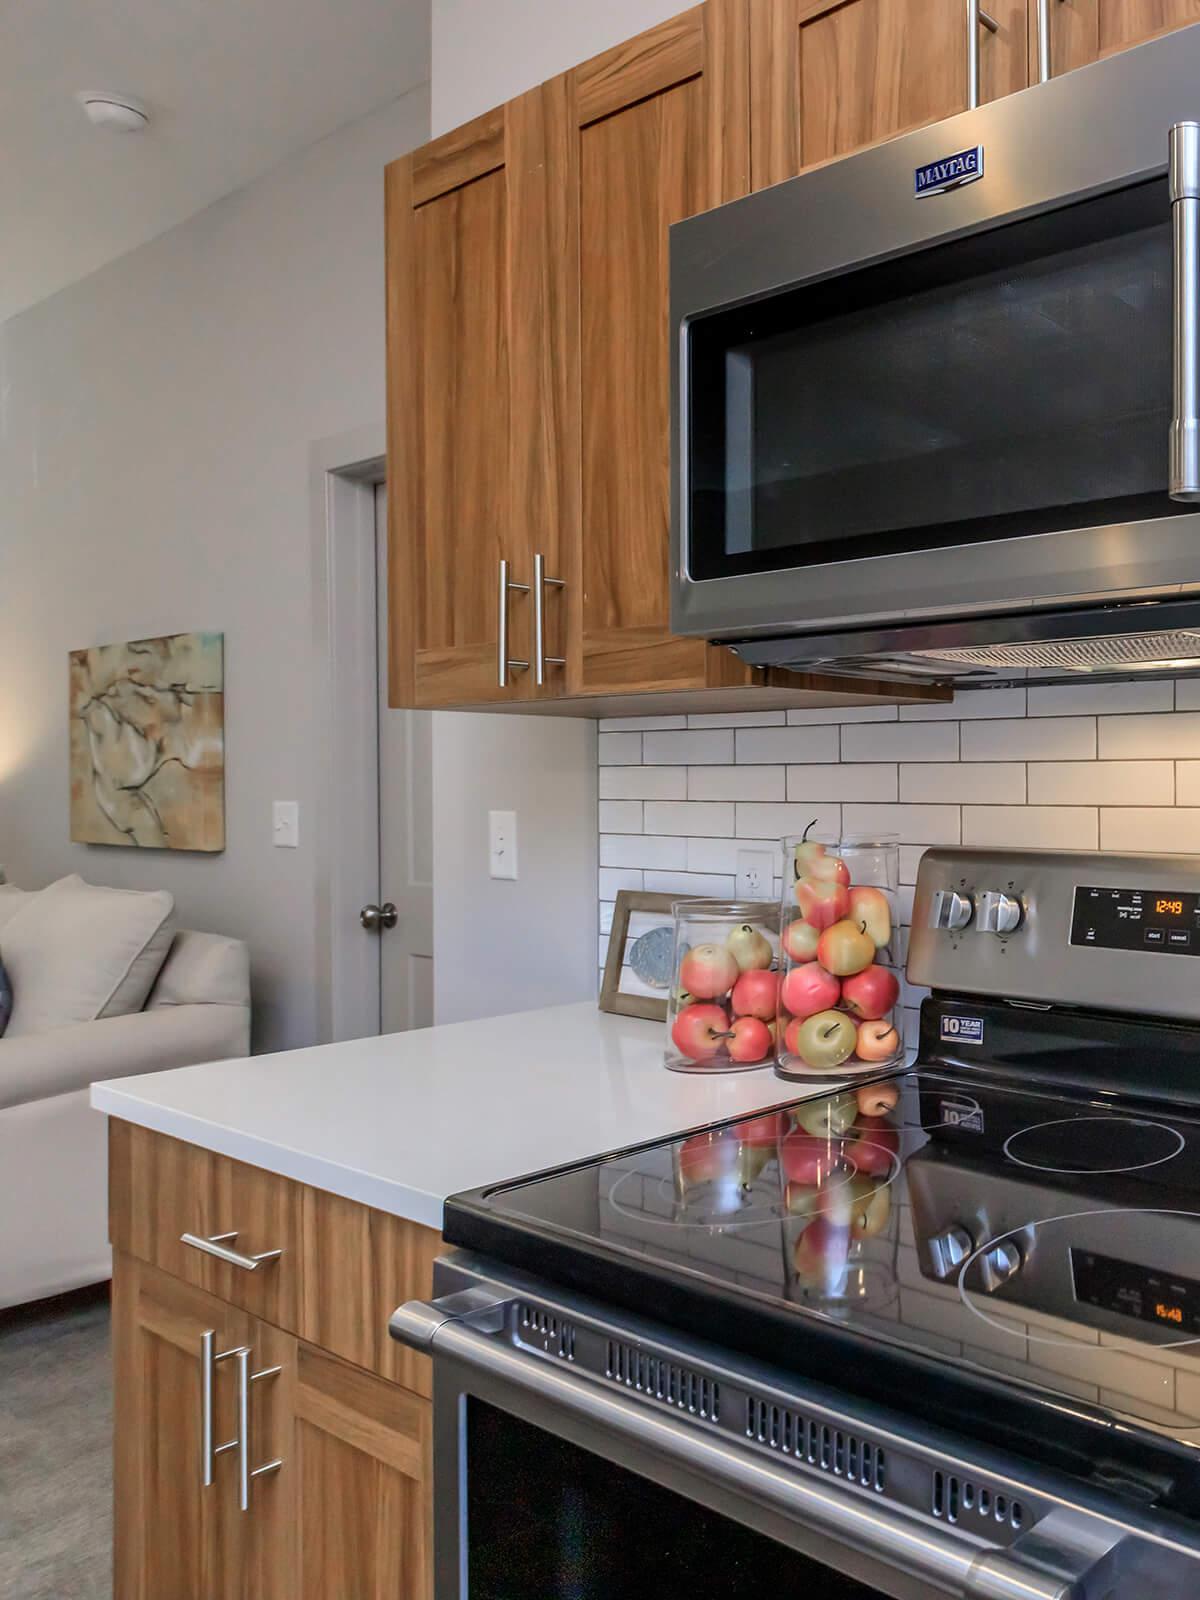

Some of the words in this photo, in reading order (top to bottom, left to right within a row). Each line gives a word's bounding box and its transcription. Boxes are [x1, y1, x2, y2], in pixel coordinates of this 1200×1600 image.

[918, 154, 976, 187] MAYTAG
[1156, 900, 1183, 914] 12:49
[943, 1018, 960, 1033] 10
[960, 1020, 981, 1028] YEAR
